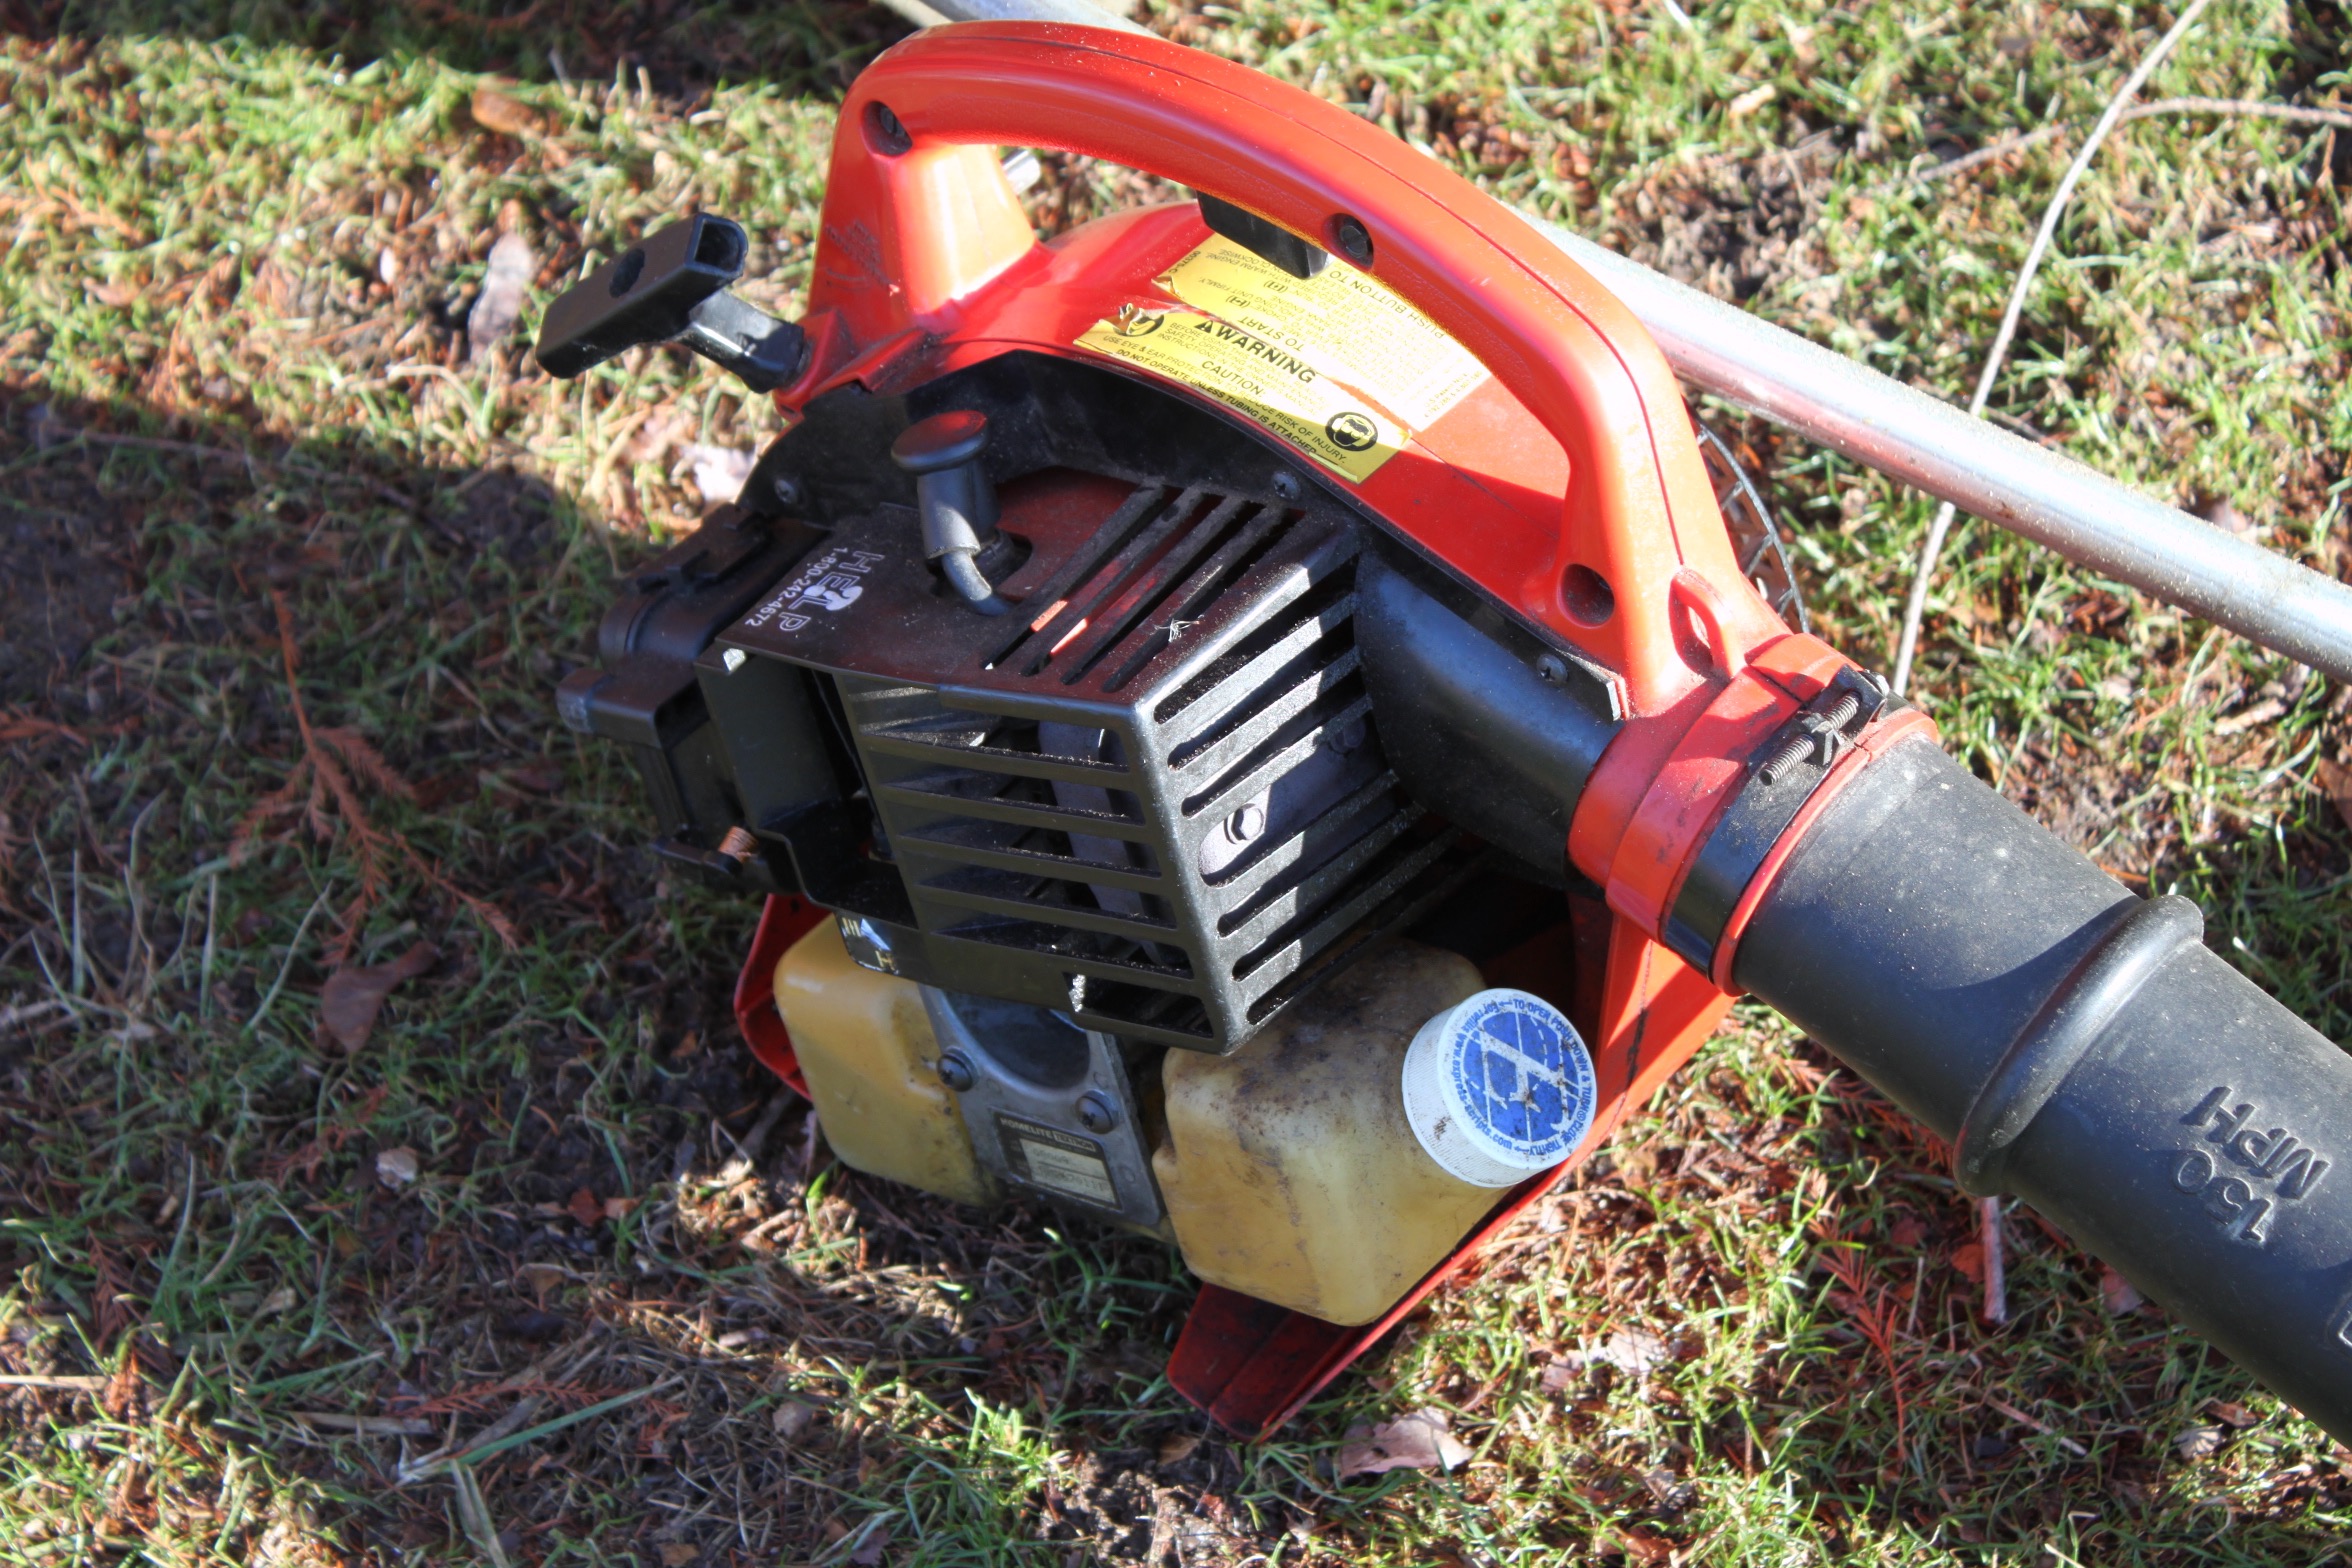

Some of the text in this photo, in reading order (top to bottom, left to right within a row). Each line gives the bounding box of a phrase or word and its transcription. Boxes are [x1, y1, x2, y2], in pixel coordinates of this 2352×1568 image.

[1328, 269, 1349, 284] TO
[1349, 279, 1407, 314] BUTTON
[1169, 322, 1202, 337] BEFORE
[1236, 314, 1304, 351] TO START
[1406, 311, 1444, 338] PUSH
[1215, 324, 1317, 384] WARNING
[1103, 334, 1122, 344] USE
[1120, 340, 1138, 349] EYE
[1146, 349, 1165, 359] EAR
[1165, 356, 1223, 384] PROTECTION
[1241, 392, 1275, 414] REDUCE
[1274, 411, 1297, 428] RISK
[1296, 426, 1313, 438] OF
[1311, 435, 1347, 463] INJURY.
[1115, 348, 1132, 358] DO
[1130, 354, 1150, 364] NOT
[1149, 359, 1189, 380] OPERATE
[1189, 377, 1228, 399] UNLESS
[1224, 395, 1258, 417] TUBING
[1258, 414, 1269, 423] IS
[745, 547, 848, 627] 1-800-242-4672
[1481, 1000, 1500, 1017] For
[1512, 998, 1524, 1010] TO
[1528, 1001, 1551, 1020] OPEN
[1550, 1015, 1574, 1041] PUSH
[1568, 1039, 1588, 1071] DOWN
[1578, 1086, 1591, 1114] TURN
[1559, 1118, 1583, 1144] CLOSE
[2185, 1086, 2332, 1200] MPH
[1528, 1138, 1562, 1155] TIGHTLY
[2173, 1149, 2273, 1243] 150
